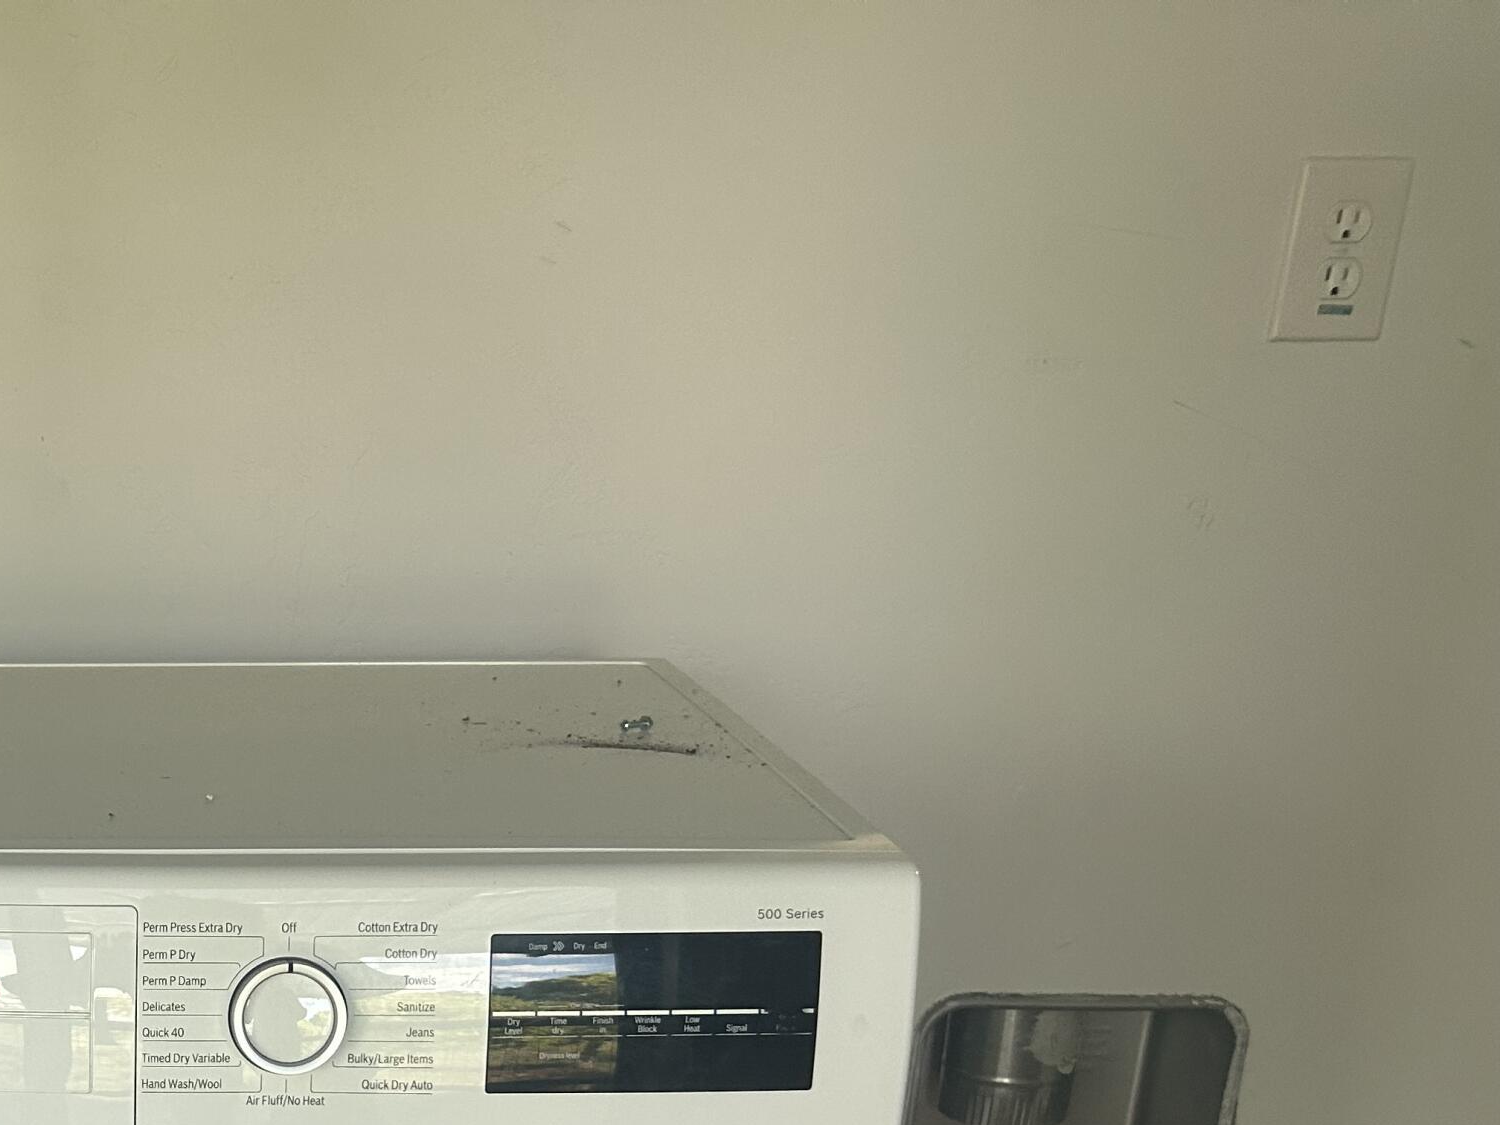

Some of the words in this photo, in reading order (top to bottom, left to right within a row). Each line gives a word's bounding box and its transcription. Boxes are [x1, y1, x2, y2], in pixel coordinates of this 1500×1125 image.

[758, 909, 781, 919] 500
[786, 908, 824, 919] Series
[143, 923, 168, 933] Perm
[170, 923, 197, 933] Press
[199, 923, 223, 933] Extra
[226, 923, 243, 935] Dry
[281, 922, 297, 933] Off
[358, 922, 391, 933] Cotton
[393, 922, 417, 933] Extra
[419, 922, 438, 935] Dry
[143, 949, 168, 960] Perm
[169, 949, 176, 959] P
[178, 949, 196, 961] Dry
[385, 949, 418, 959] Cotton
[420, 949, 437, 960] Dry
[142, 976, 167, 986] Perm
[169, 976, 175, 986] P
[177, 976, 206, 988] Damp
[404, 975, 436, 985] Towels
[142, 1002, 185, 1012] Delicates
[397, 1002, 435, 1012] Sanitize
[635, 1016, 662, 1025] Wrinkle
[685, 1016, 700, 1024] Low
[142, 1028, 169, 1038] Quick
[171, 1028, 184, 1038] 40
[406, 1028, 434, 1038] Jeans
[638, 1025, 658, 1033] Block
[683, 1024, 700, 1033] Heat
[726, 1024, 748, 1033] Signal
[142, 1053, 171, 1063] Timed
[173, 1053, 191, 1065] Dry
[192, 1053, 230, 1063] Variable
[347, 1054, 405, 1067] Bulky/Large
[407, 1054, 433, 1064] Items
[142, 1079, 166, 1089] Hand
[169, 1079, 222, 1090] Wash/Wool
[362, 1080, 389, 1090] Quick
[391, 1080, 408, 1092] Dry
[410, 1080, 433, 1090] Auto
[246, 1096, 260, 1106] Air
[262, 1096, 300, 1107] Fluff/No
[303, 1096, 324, 1106] Heat
